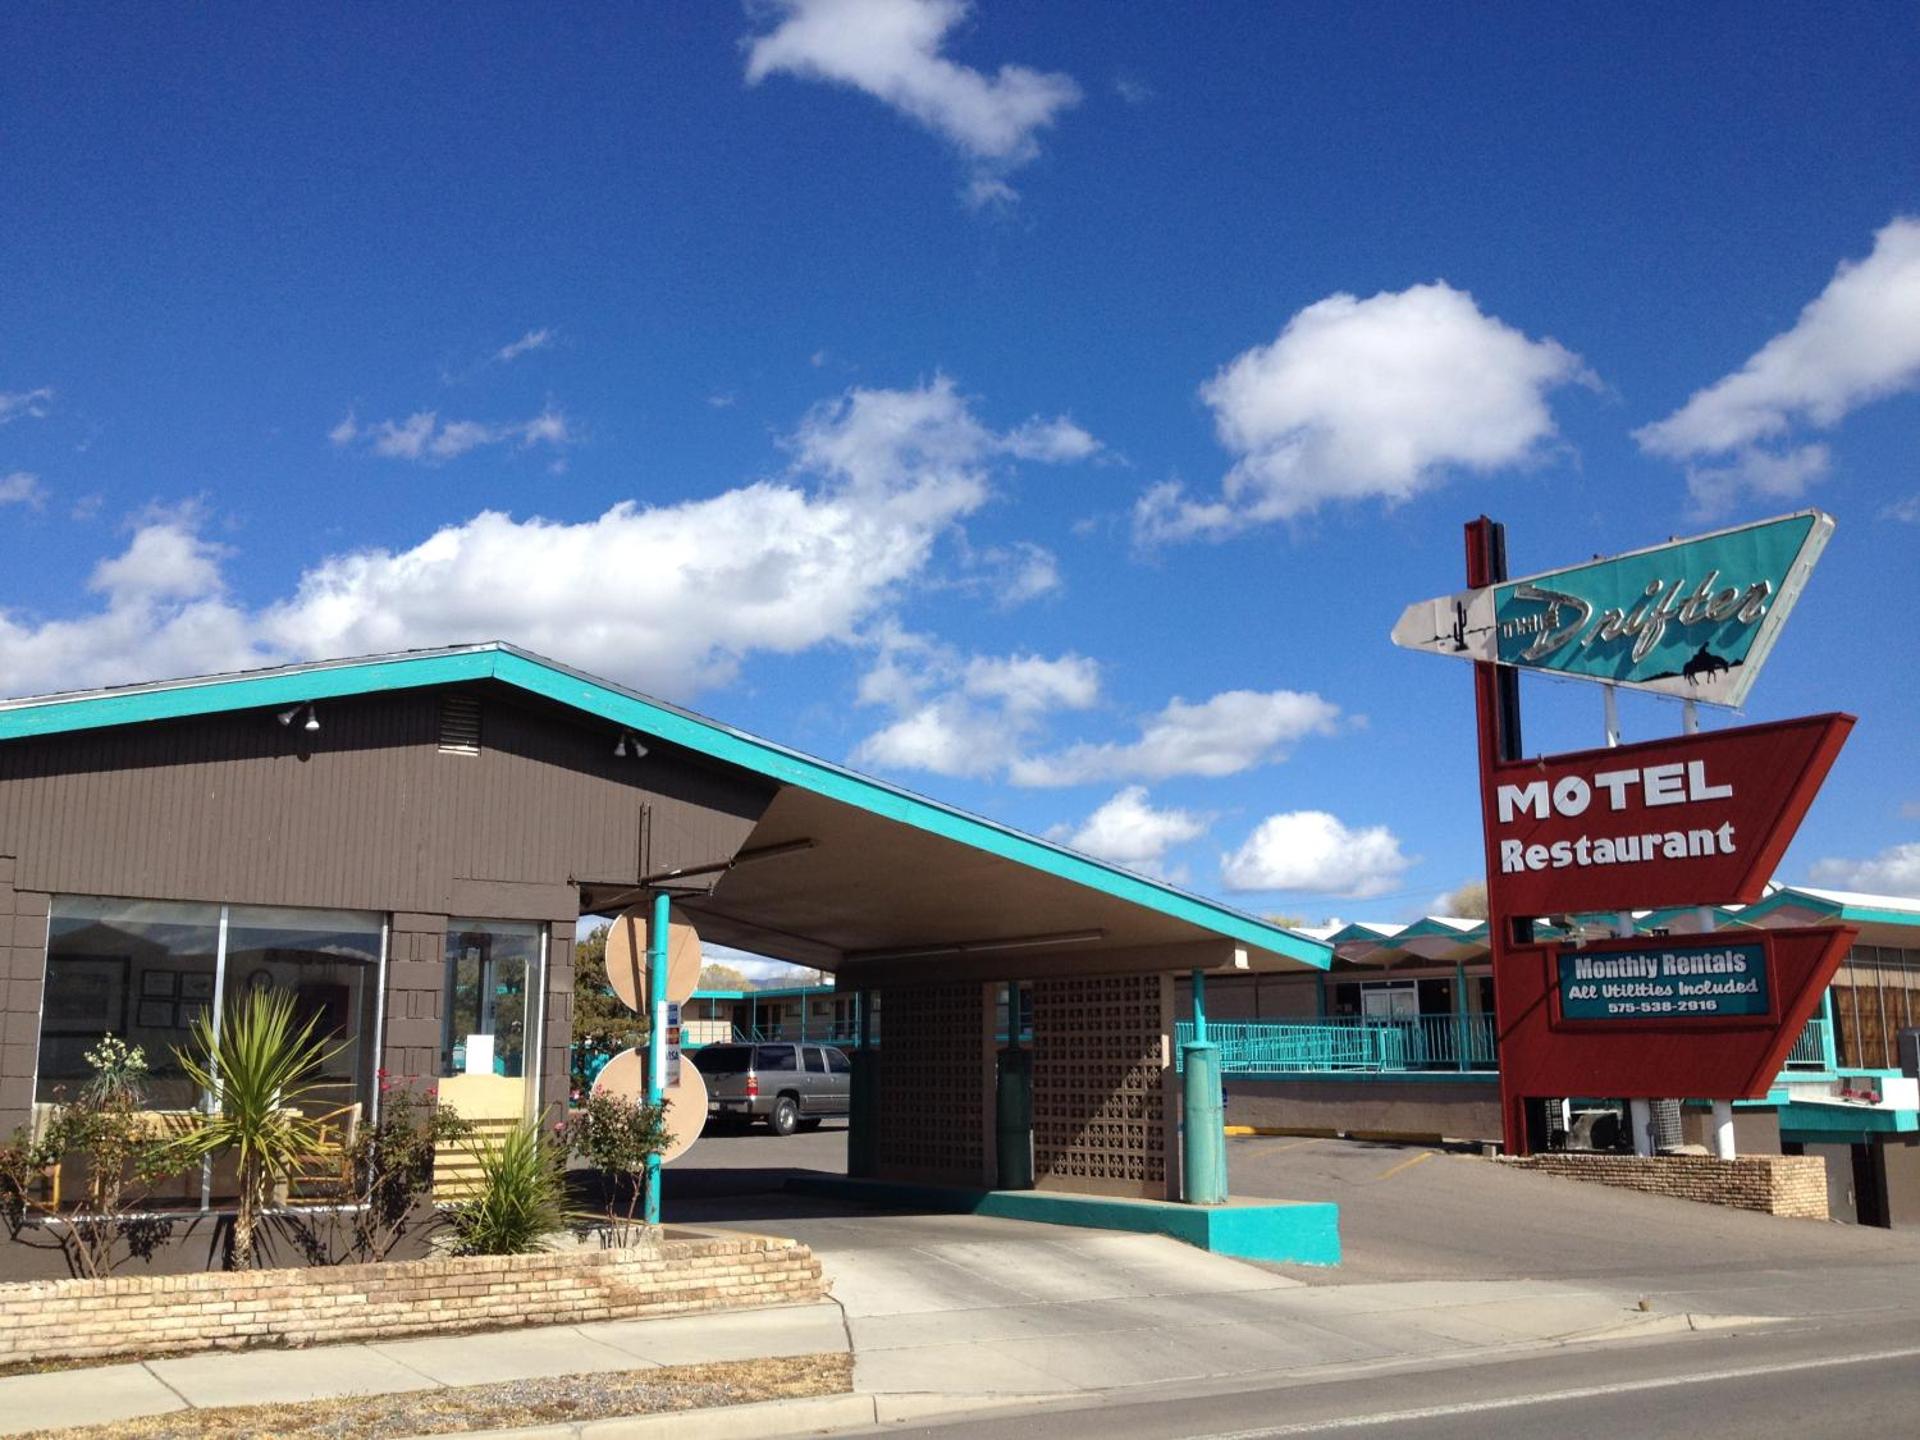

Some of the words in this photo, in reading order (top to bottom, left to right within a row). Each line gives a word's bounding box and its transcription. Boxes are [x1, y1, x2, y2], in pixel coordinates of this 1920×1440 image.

[1498, 603, 1560, 638] THE
[1514, 569, 1773, 664] Drifter
[1497, 760, 1733, 823] MOTEL
[1500, 821, 1736, 873] Restaurant
[1575, 954, 1657, 979] Monthly
[1663, 950, 1747, 975] Rentals
[1568, 983, 1598, 999] All
[1602, 982, 1674, 998] Utilities
[1679, 978, 1759, 995] Included
